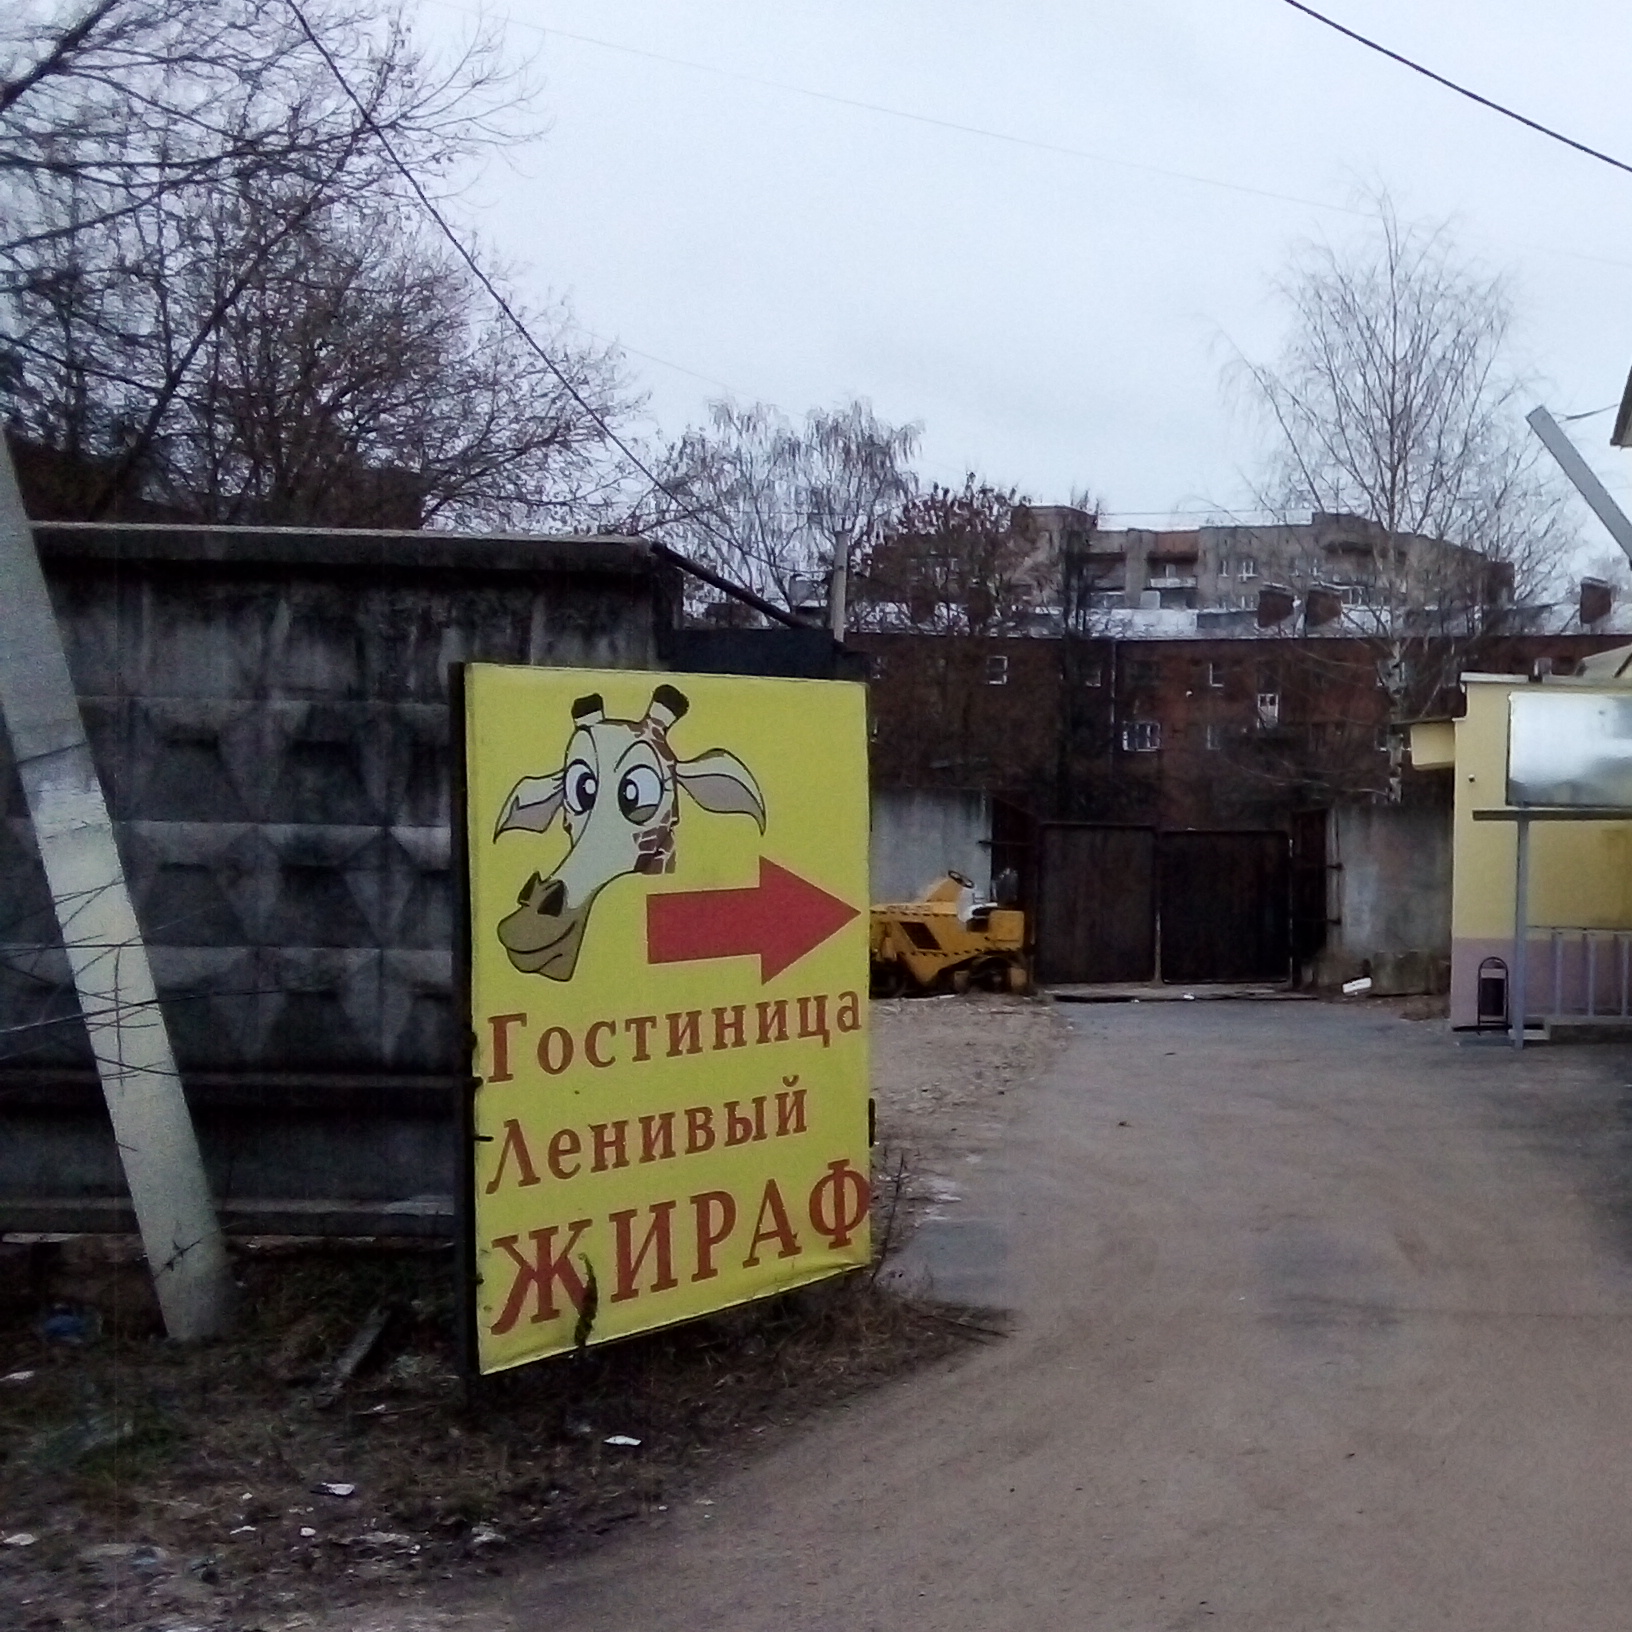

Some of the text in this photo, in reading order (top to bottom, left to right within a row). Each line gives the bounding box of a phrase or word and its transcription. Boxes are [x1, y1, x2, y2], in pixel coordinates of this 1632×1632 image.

[486, 989, 863, 1085] Гостиница
[485, 1074, 809, 1195] Ленивый
[490, 1158, 872, 1336] ЖИРАФ
